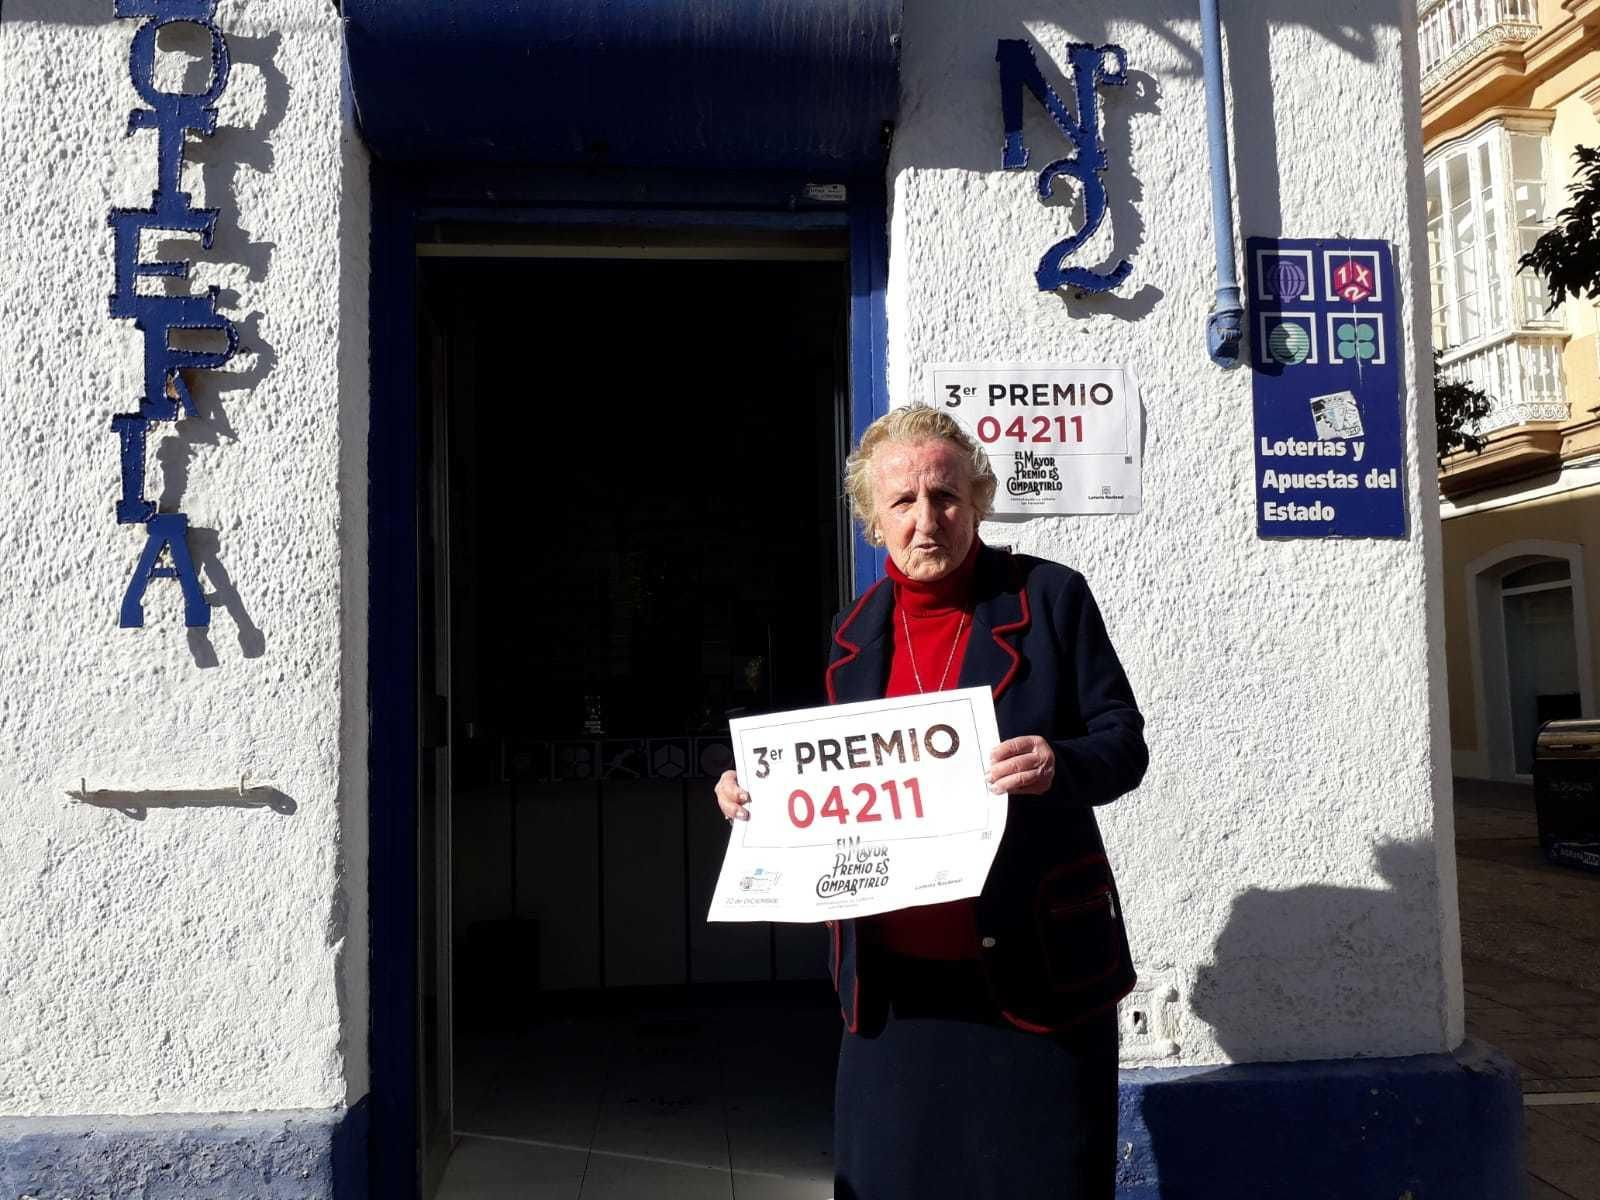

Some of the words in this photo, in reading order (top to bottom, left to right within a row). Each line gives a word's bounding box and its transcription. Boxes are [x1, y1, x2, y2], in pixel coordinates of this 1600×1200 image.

[1035, 156, 1134, 291] 2
[108, 0, 239, 628] OTERIA
[945, 384, 977, 408] 3er
[988, 383, 1114, 407] PREMIO
[977, 415, 1084, 443] 04211
[1014, 452, 1024, 461] EL
[1024, 450, 1056, 470] MAYOR
[1352, 441, 1365, 461] y
[1014, 461, 1047, 481] PREMIO
[1048, 466, 1060, 481] ES
[1262, 468, 1359, 493] Apuestas
[1364, 468, 1397, 489] del
[1006, 476, 1063, 496] COMPARTIRLO
[1263, 501, 1335, 522] Estado
[753, 746, 783, 779] 3er
[794, 723, 960, 775] PREMIO
[787, 777, 924, 829] 04211
[832, 853, 874, 879] PREMIO
[875, 857, 890, 875] ES
[815, 874, 889, 898] COMPARTIRLO
